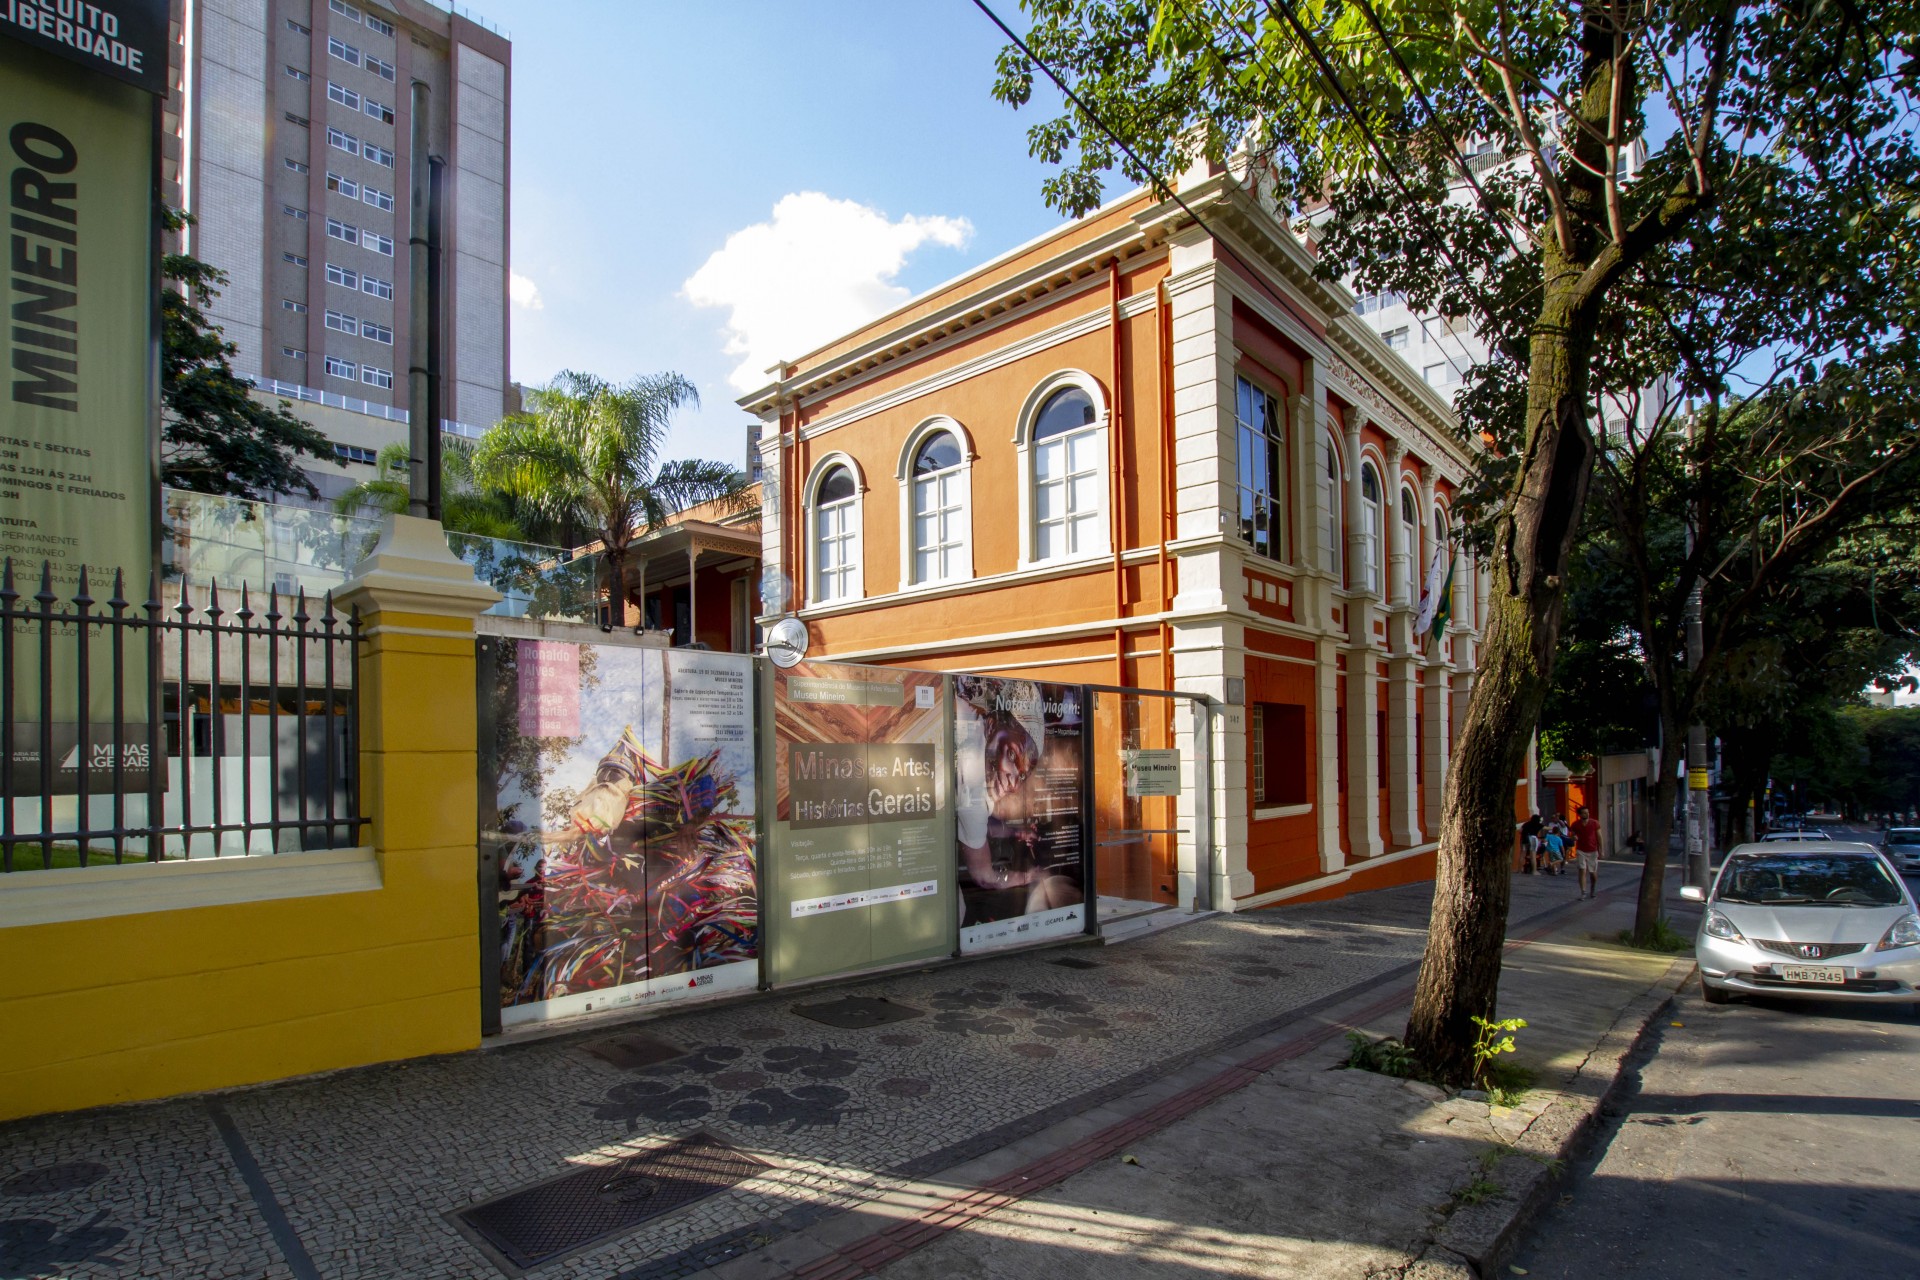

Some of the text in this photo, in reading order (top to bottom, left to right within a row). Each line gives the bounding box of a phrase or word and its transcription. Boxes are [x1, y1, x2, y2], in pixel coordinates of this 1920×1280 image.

[10, 122, 78, 412] MINEIRO
[0, 450, 19, 460] 9H
[33, 441, 41, 450] E
[45, 443, 91, 457] SEXTAS
[21, 466, 44, 476] 12H
[69, 473, 91, 483] 21H
[0, 477, 126, 500] MINGOS E FERIADOS
[0, 490, 19, 500] 9H
[2, 531, 79, 546] PERMANENTE
[525, 647, 570, 661] Ronaldo
[524, 664, 555, 677] Alves
[793, 690, 846, 701] Museu Mineiro
[540, 705, 568, 717] Sertão
[996, 695, 1027, 711] Notas
[1043, 697, 1080, 718] viagem:
[795, 751, 935, 780] Minas das Artes,
[795, 787, 931, 821] Histórias Gerais
